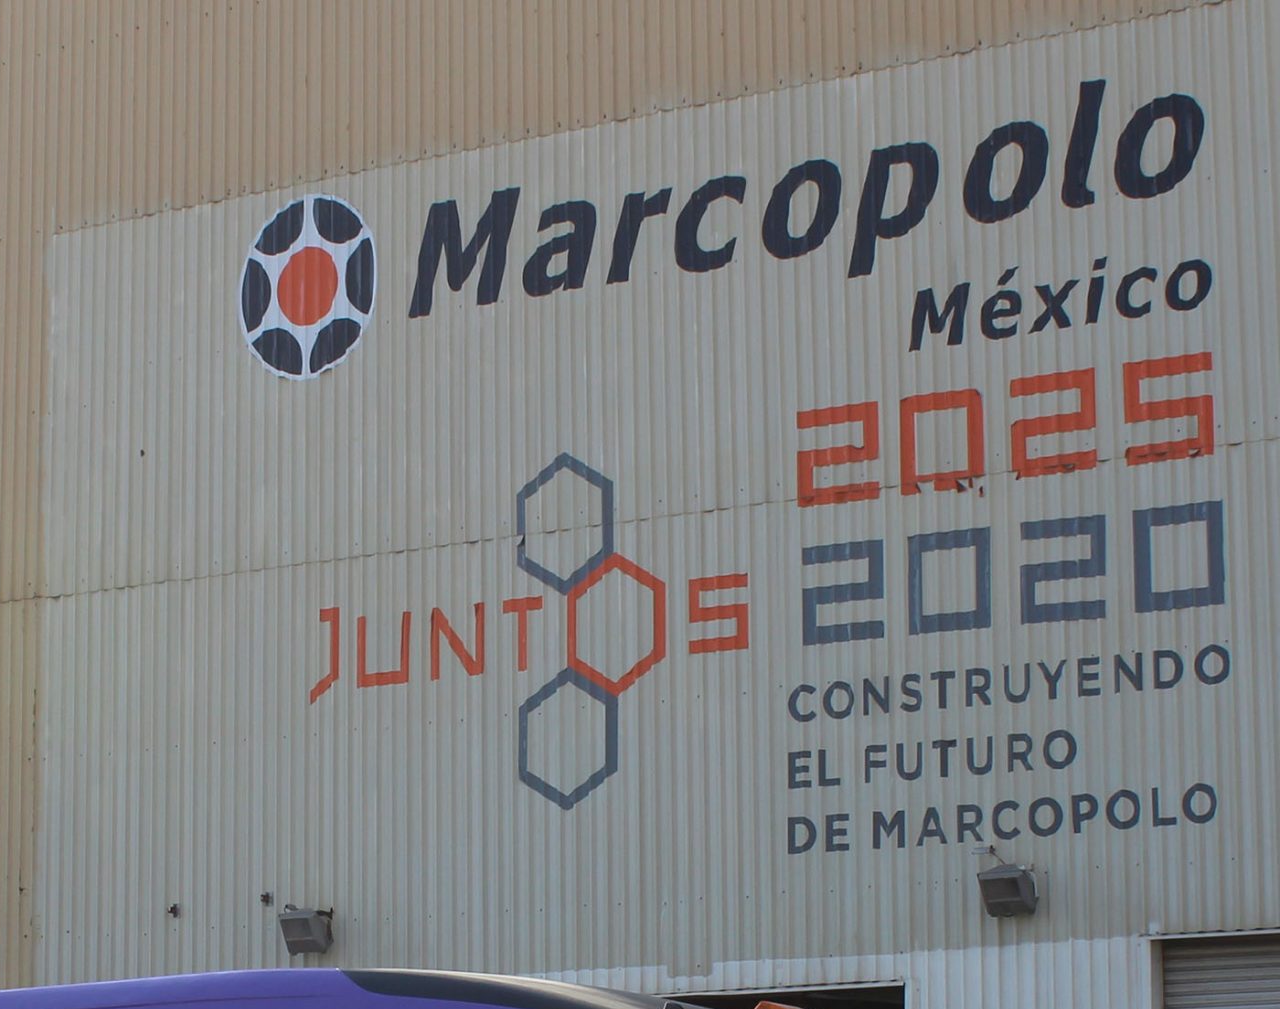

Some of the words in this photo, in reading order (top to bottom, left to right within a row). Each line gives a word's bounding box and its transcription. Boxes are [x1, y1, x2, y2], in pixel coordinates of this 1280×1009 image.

[409, 80, 1205, 318] Marcopolo
[908, 256, 1212, 351] México
[796, 352, 1213, 507] 2025
[802, 500, 1225, 645] 2020
[788, 643, 1231, 722] CONSTRUYENDO
[787, 749, 841, 788] EL
[863, 729, 1077, 783] FUTURO
[786, 813, 850, 853] DE
[871, 782, 1218, 851] MARCOPOLO
